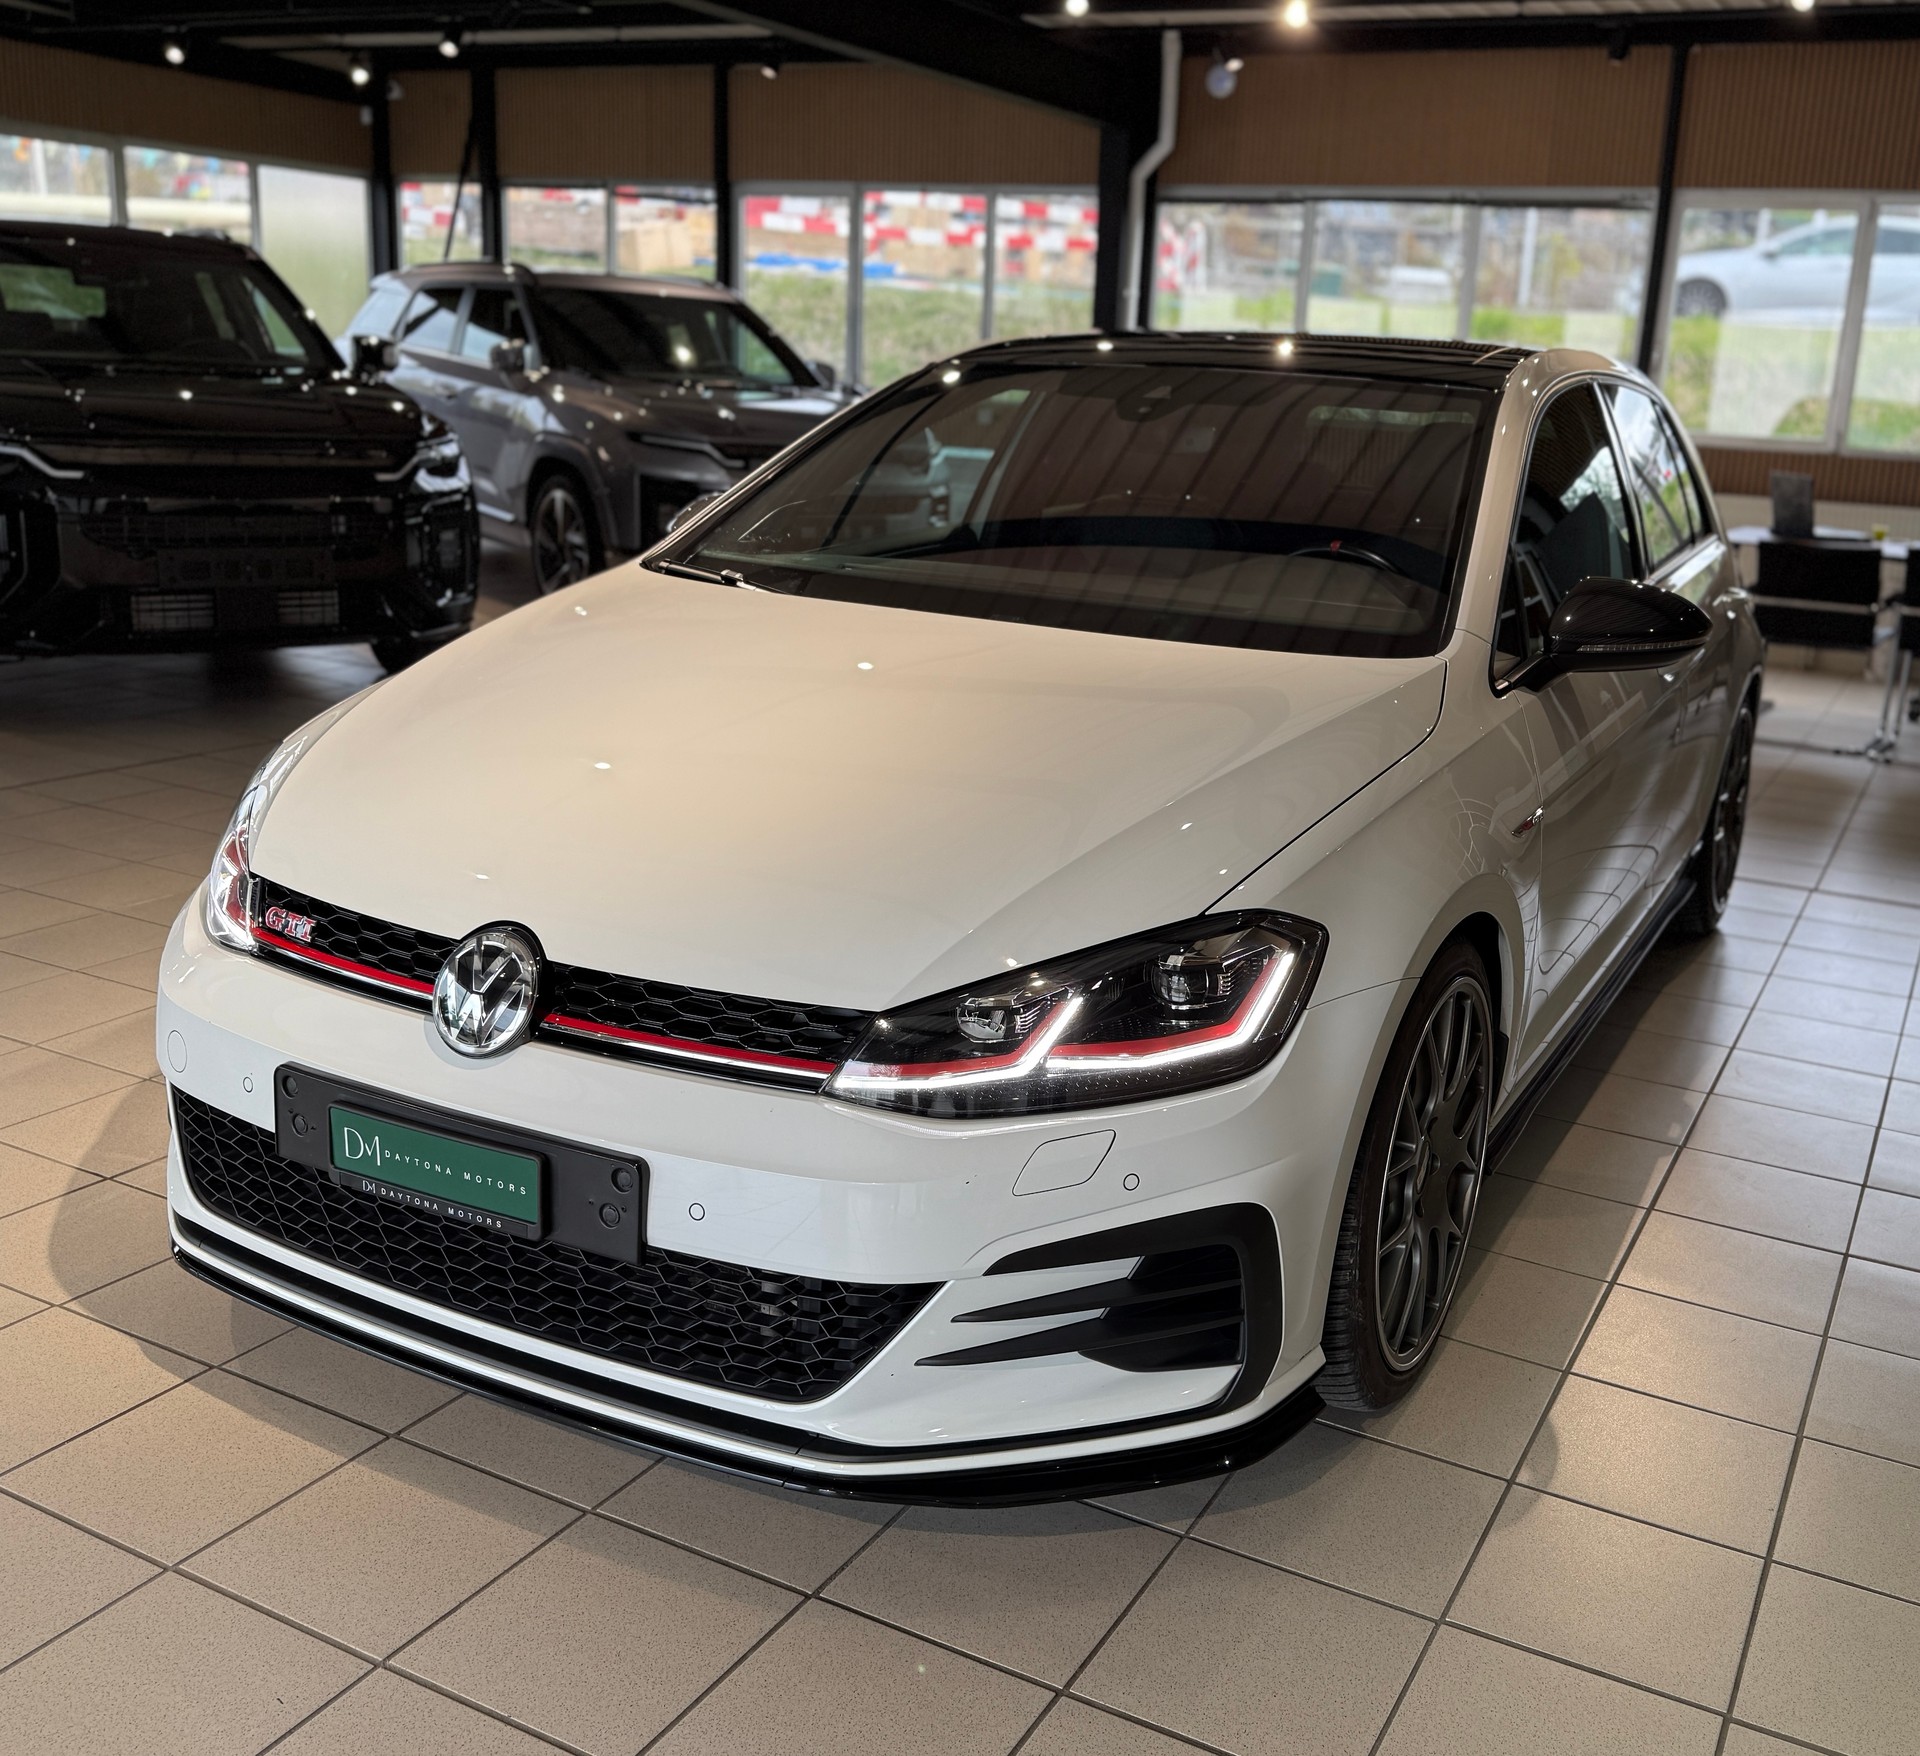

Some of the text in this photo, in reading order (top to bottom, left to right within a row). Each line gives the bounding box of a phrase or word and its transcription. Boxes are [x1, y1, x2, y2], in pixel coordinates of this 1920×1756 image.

[265, 906, 317, 942] GTI
[439, 932, 533, 1050] VW
[384, 1150, 452, 1176] DAYTONA
[463, 1171, 527, 1196] MOTORS
[381, 1187, 439, 1211] DAYTONA
[448, 1207, 502, 1228] MOTORS
